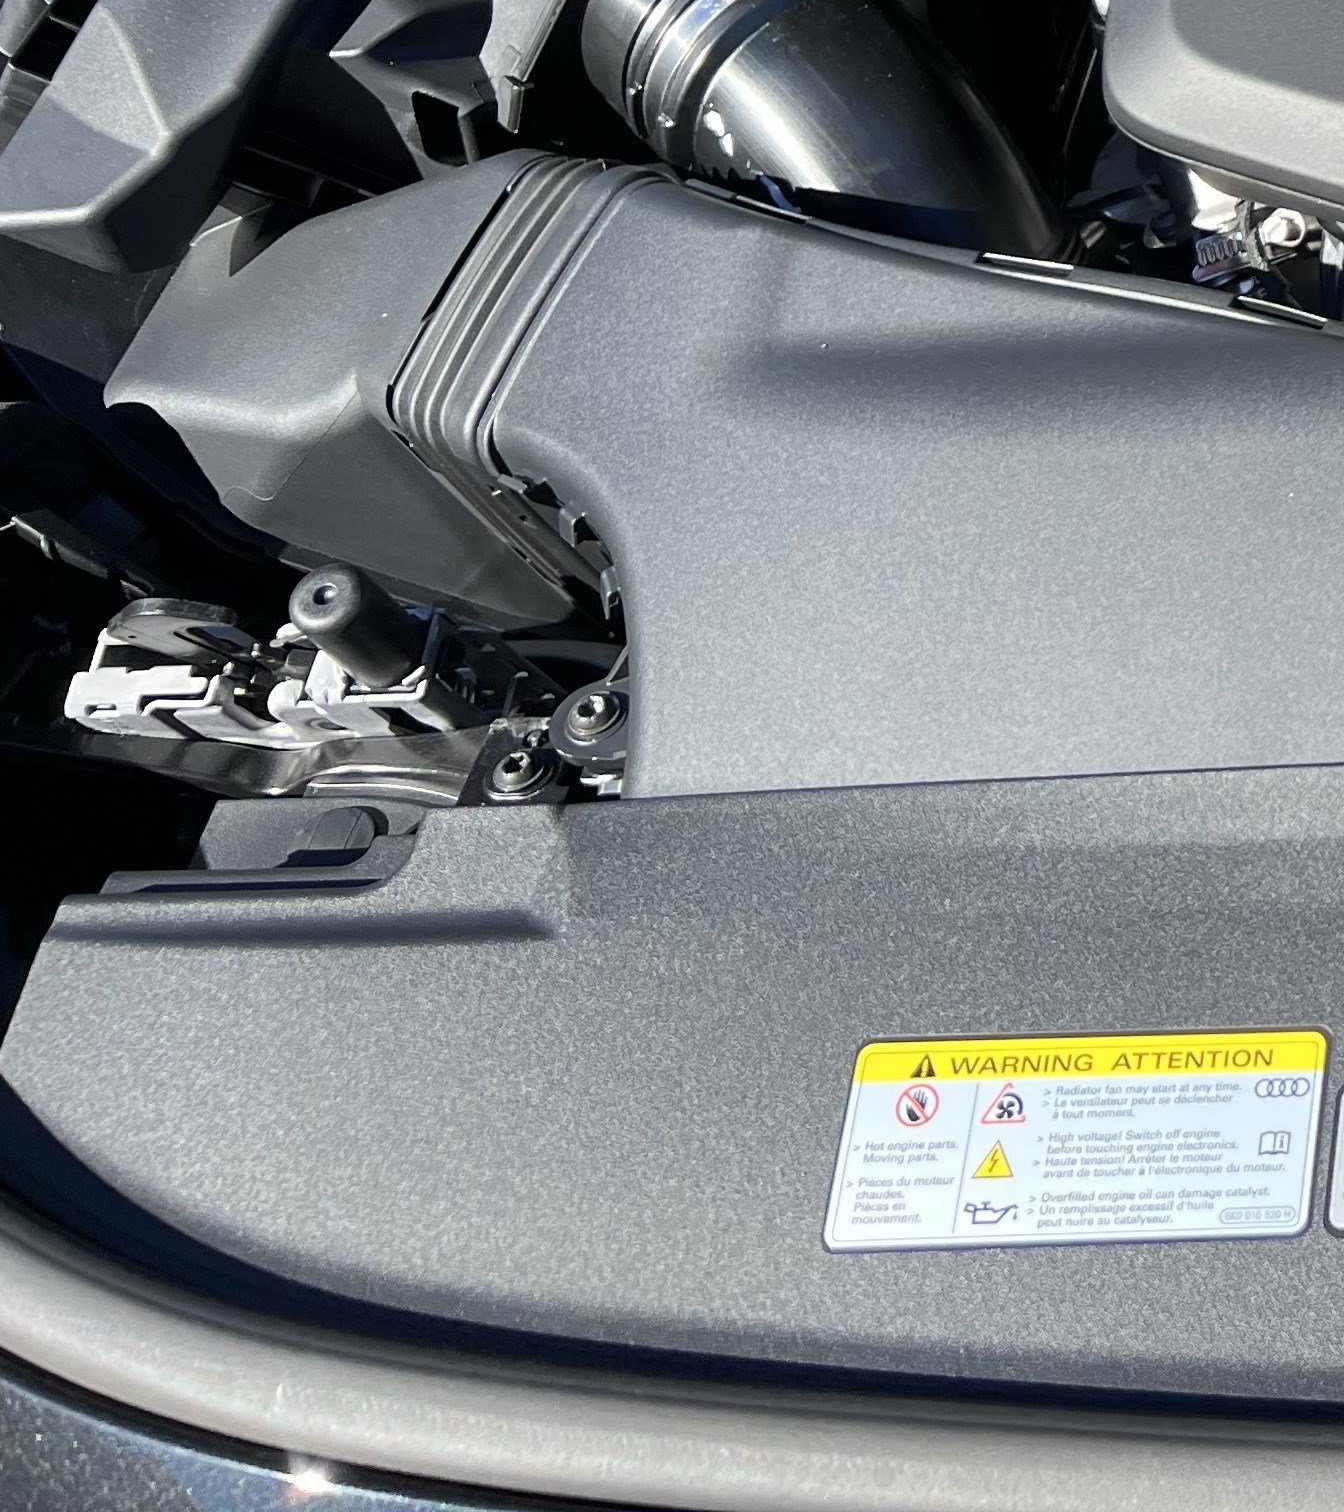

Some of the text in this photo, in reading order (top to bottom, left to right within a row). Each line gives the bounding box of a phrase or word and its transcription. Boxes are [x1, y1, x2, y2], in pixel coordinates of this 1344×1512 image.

[951, 1048, 1274, 1075] WARNING ATTENTION
[1056, 1085, 1102, 1095] Radiator
[1106, 1084, 1123, 1094] fan
[1126, 1086, 1149, 1096] may
[1152, 1083, 1176, 1092] start
[1179, 1084, 1189, 1092] at
[1193, 1084, 1212, 1094] any
[1054, 1098, 1067, 1108] Le
[1070, 1097, 1128, 1107] ventilateur
[1131, 1098, 1156, 1107] peut
[1062, 1108, 1084, 1118] tout
[1049, 1129, 1220, 1144] High voltage! Switch off engine
[865, 1139, 958, 1153] Hot engine parts.
[1047, 1144, 1082, 1154] before
[1086, 1142, 1132, 1154] touching
[1136, 1142, 1173, 1153] engine
[863, 1152, 938, 1164] Moving parts.
[1046, 1157, 1076, 1166] Haute
[1170, 1154, 1179, 1162] le
[1182, 1152, 1222, 1162] moteur
[1043, 1169, 1074, 1178] avant
[1077, 1168, 1090, 1178] de
[1094, 1166, 1135, 1177] toucher
[1226, 1163, 1240, 1172] du
[900, 1177, 911, 1186] du
[914, 1176, 954, 1186] moteur
[1041, 1192, 1095, 1203] Overfilled
[1099, 1191, 1135, 1202] engine
[1139, 1190, 1151, 1199] oil
[1178, 1188, 1222, 1200] damage
[1040, 1205, 1055, 1214] Un
[1058, 1203, 1126, 1216] remplissage
[1130, 1201, 1174, 1212] excessif
[1038, 1217, 1060, 1228] peut
[1062, 1216, 1094, 1226] nuire
[1097, 1217, 1110, 1225] au
